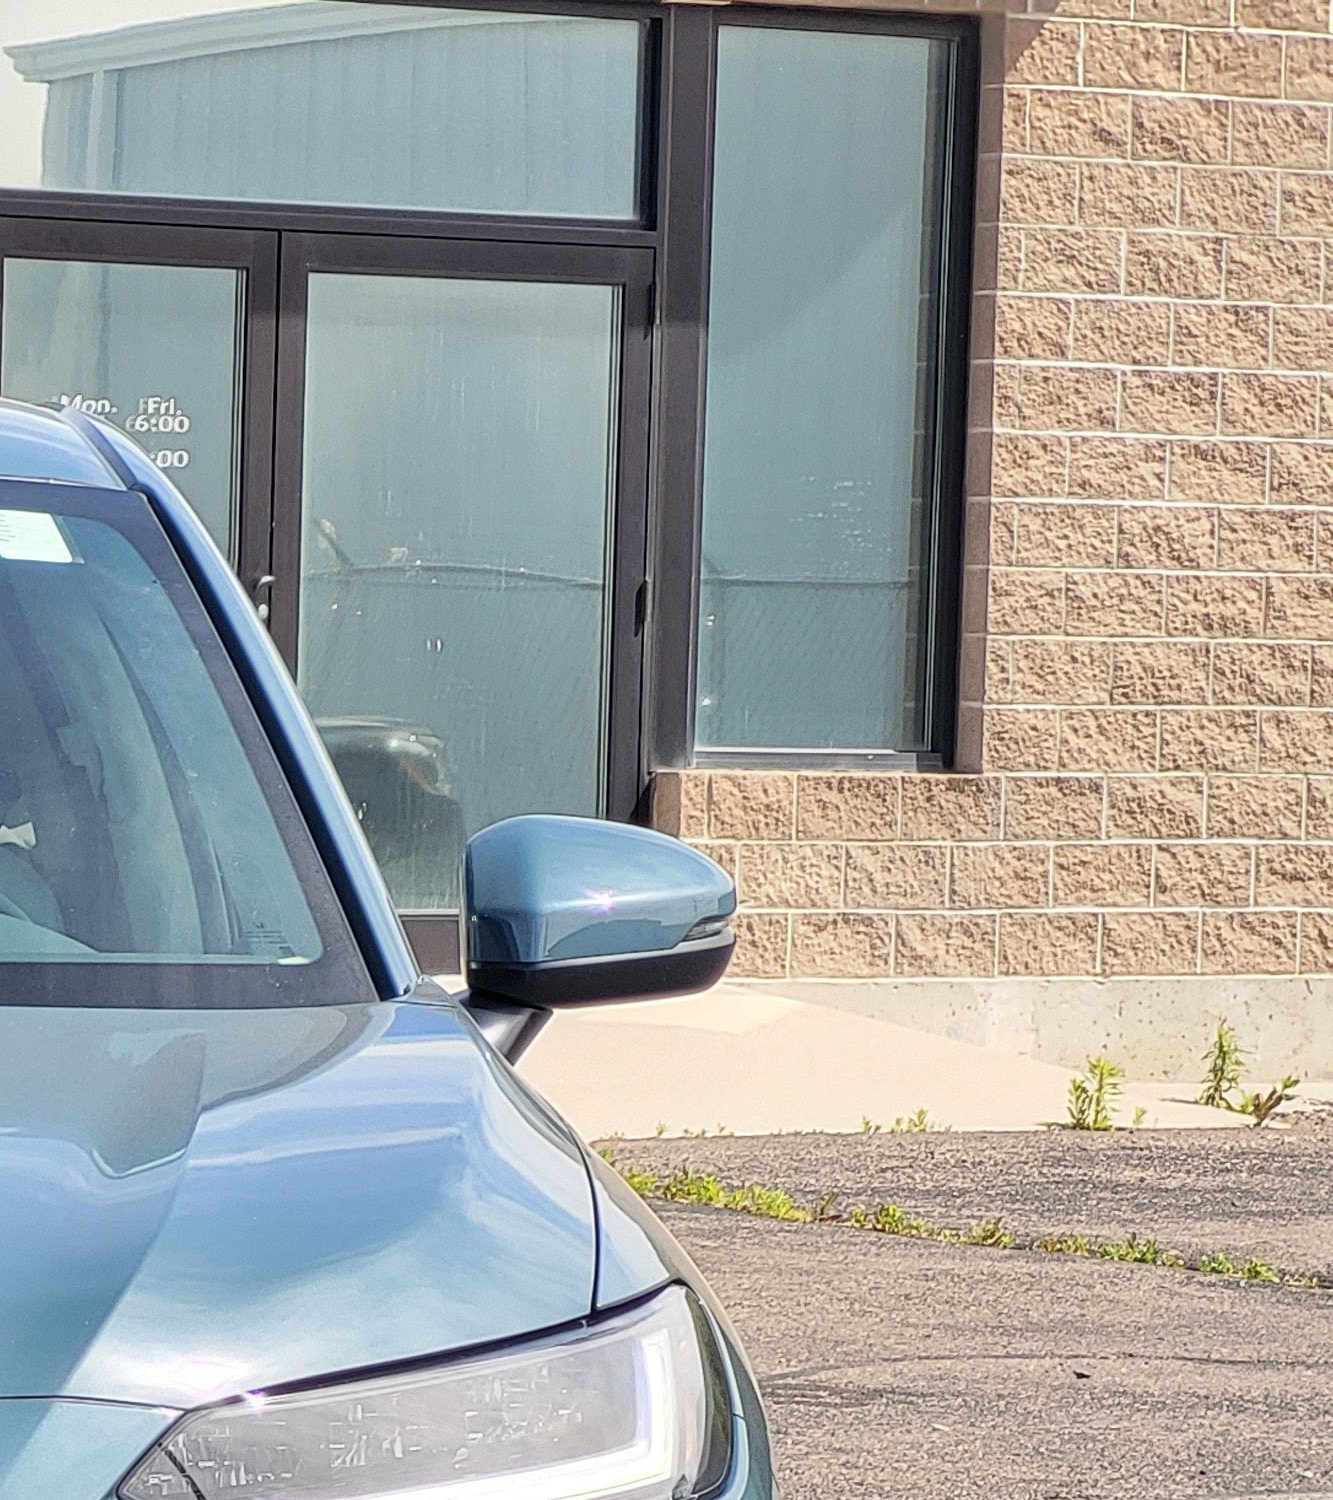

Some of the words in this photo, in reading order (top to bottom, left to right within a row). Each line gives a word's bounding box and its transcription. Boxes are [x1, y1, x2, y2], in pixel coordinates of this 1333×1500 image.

[146, 396, 182, 415] Fri.
[134, 415, 190, 433] 6:00
[149, 450, 190, 468] :00
